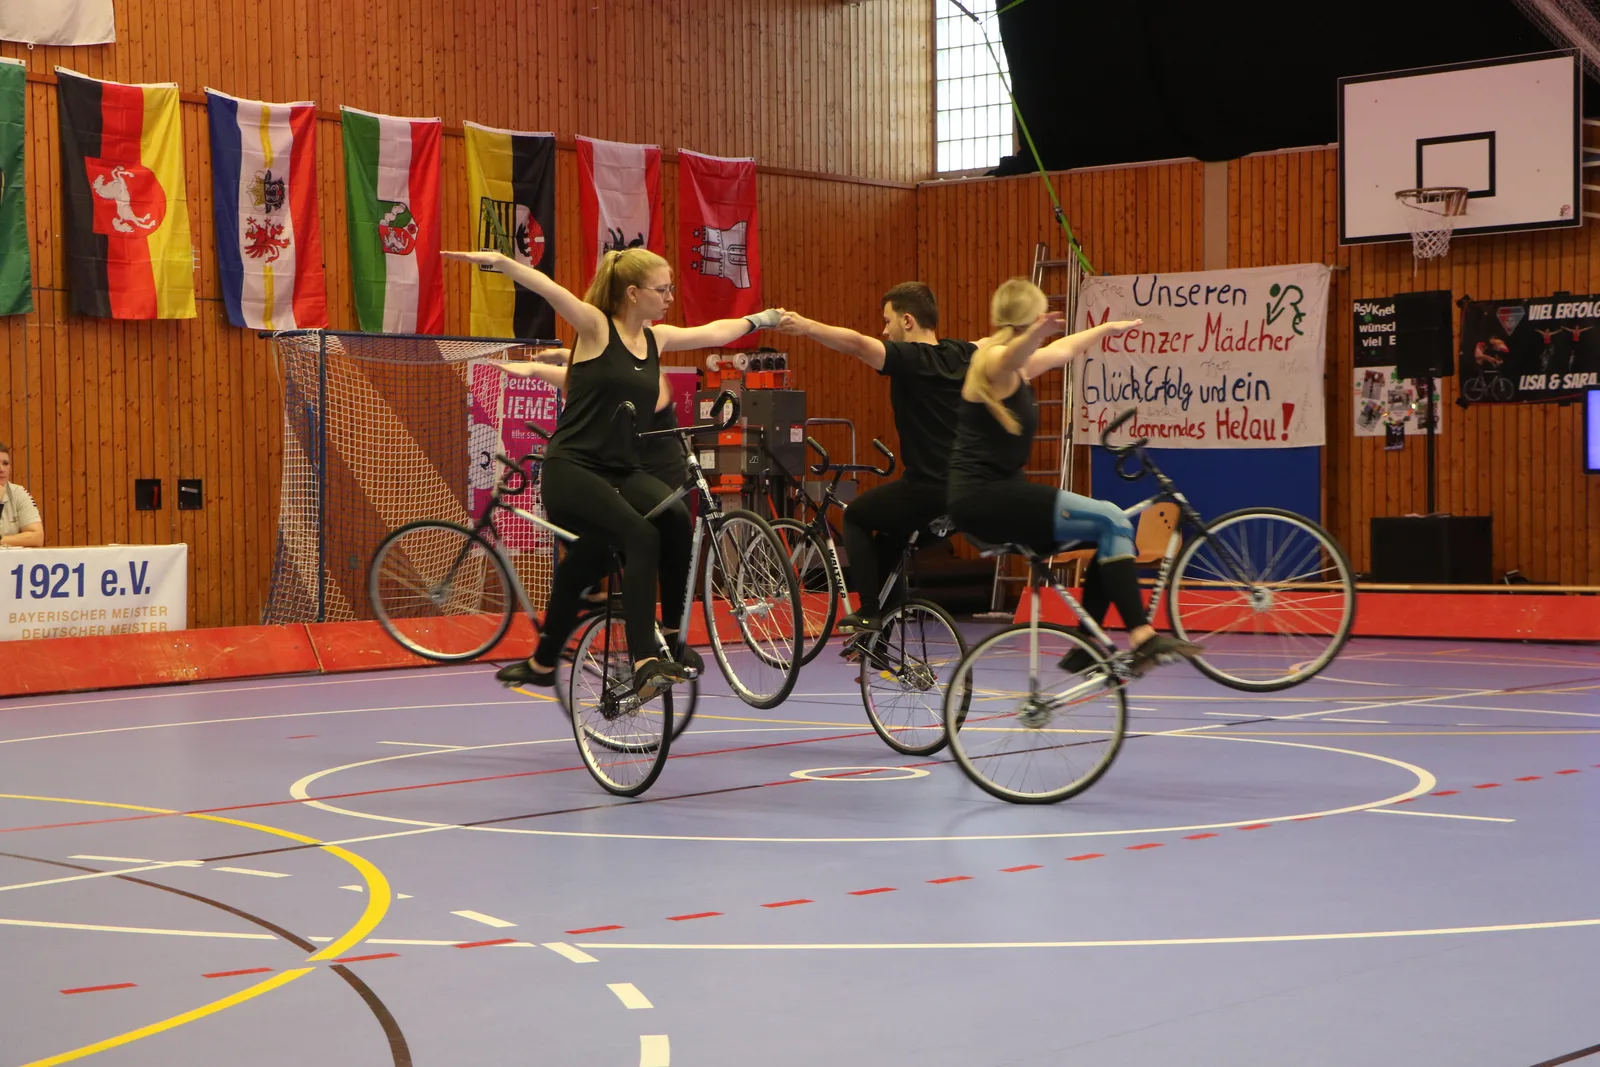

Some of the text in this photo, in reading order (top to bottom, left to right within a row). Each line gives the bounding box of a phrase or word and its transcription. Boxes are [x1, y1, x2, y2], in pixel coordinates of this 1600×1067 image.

[1132, 274, 1247, 308] Unseren
[1528, 301, 1600, 320] VIEL ERFOLG
[1198, 311, 1295, 353] Mädcher
[1362, 336, 1382, 347] viel
[1199, 374, 1227, 403] und
[1232, 372, 1270, 402] ein
[1519, 372, 1597, 391] LISA & SARA
[11, 560, 151, 600] 1921 e.V.
[8, 606, 168, 624] BAYERISCHER MEISTER
[21, 621, 168, 641] DEUTSCHER MEISTER
